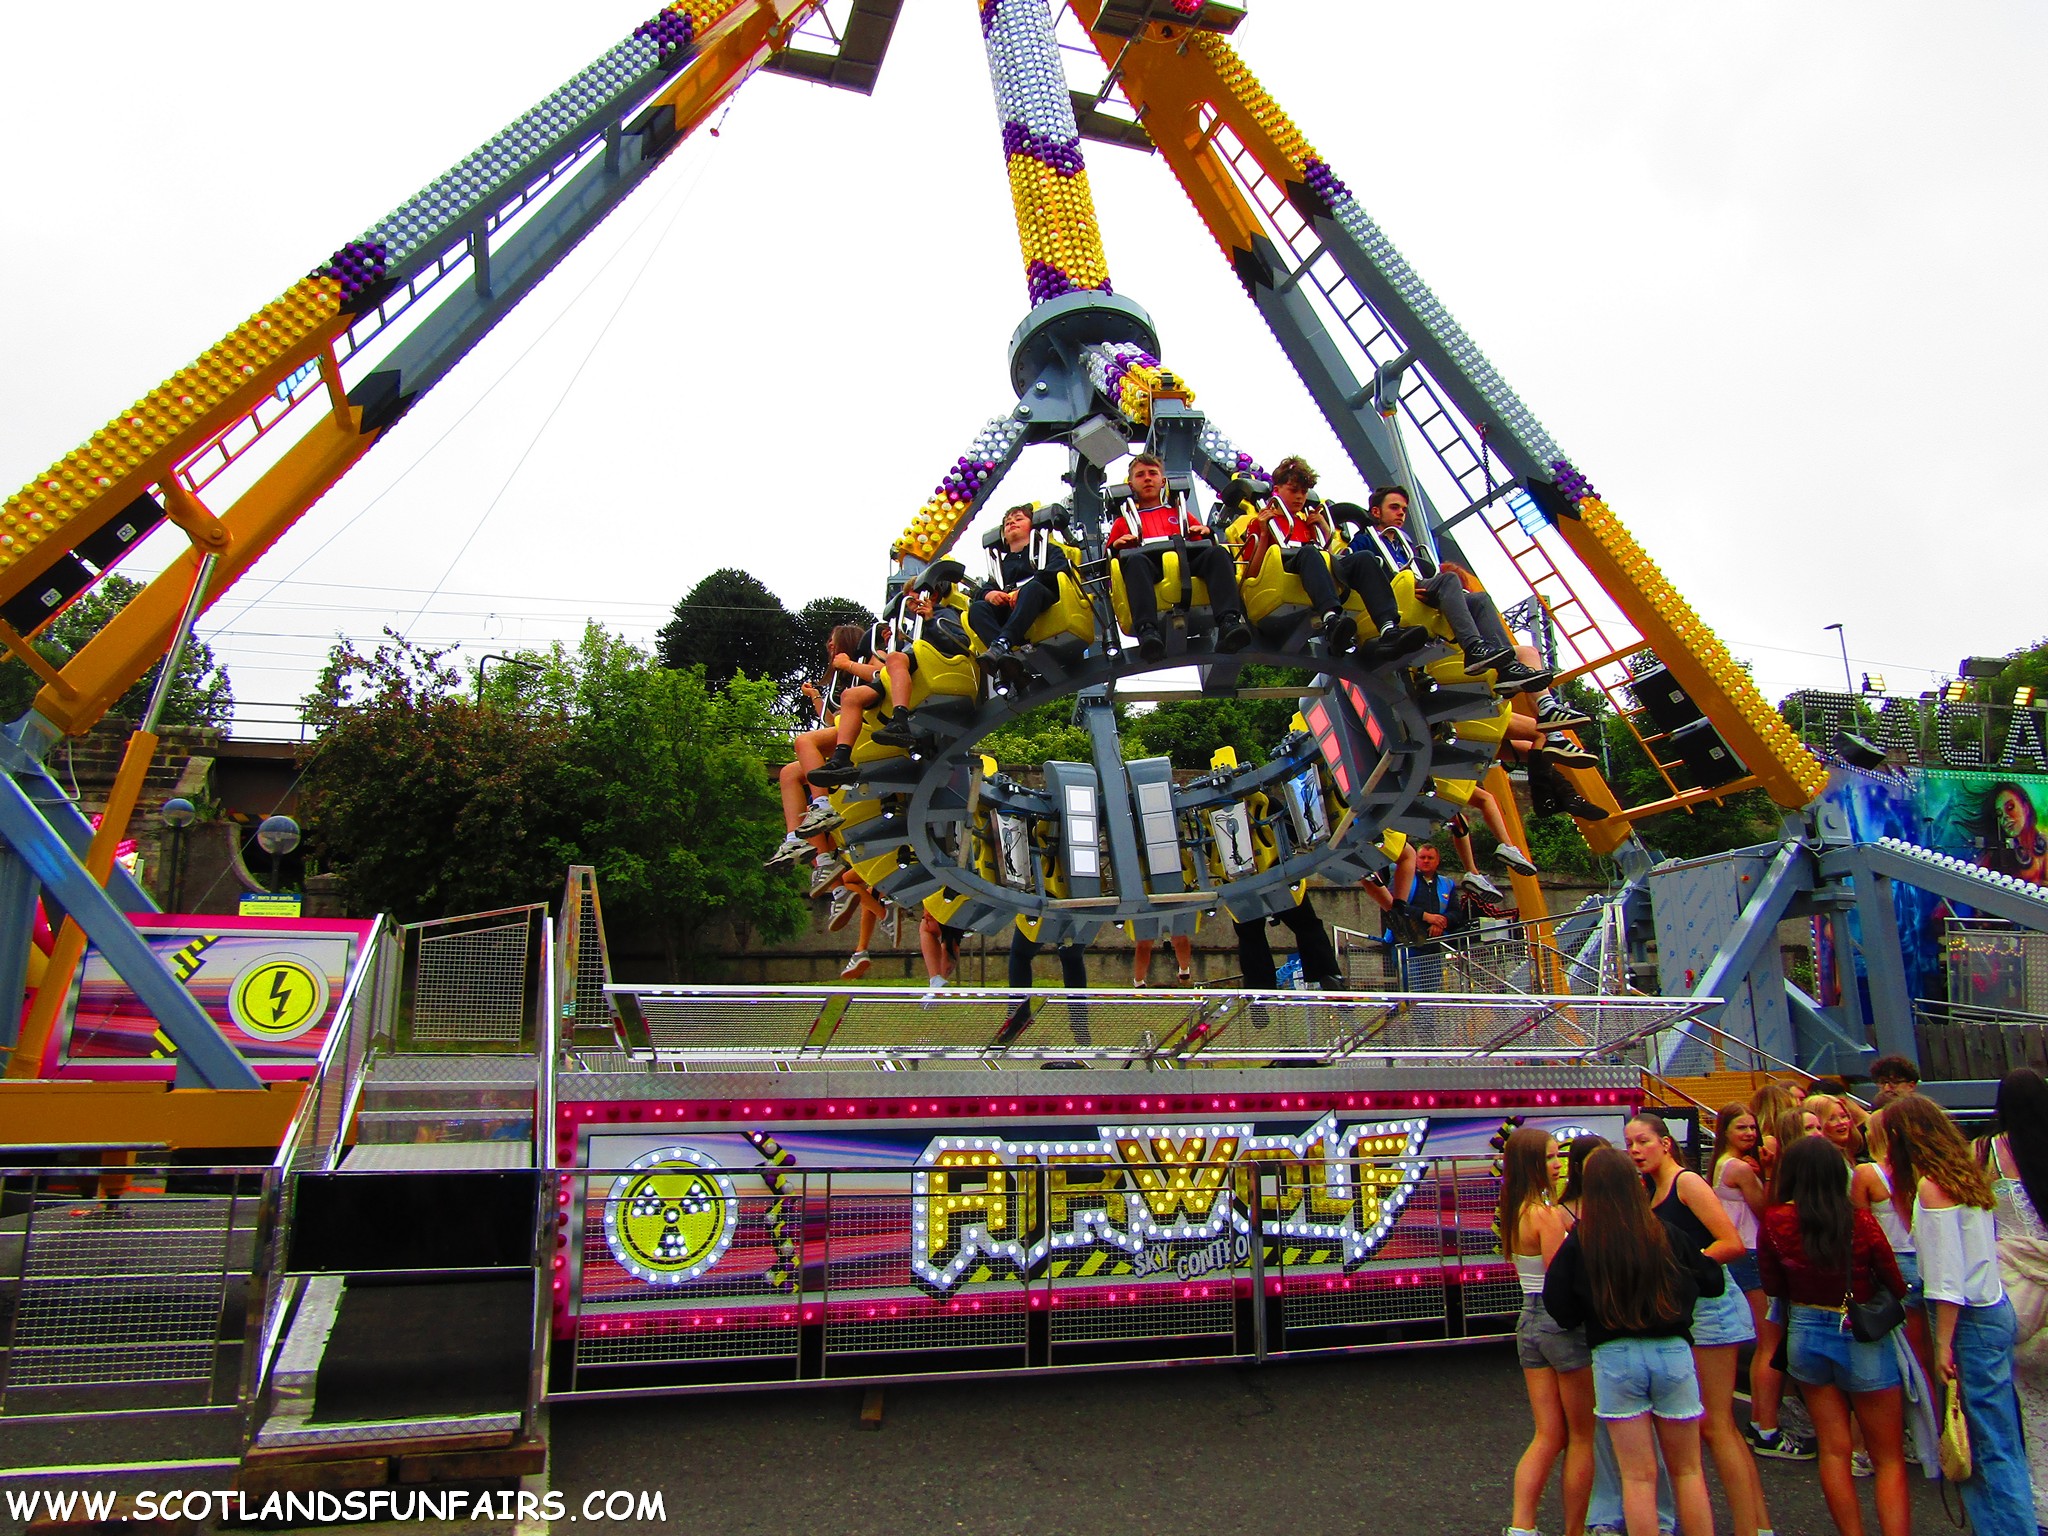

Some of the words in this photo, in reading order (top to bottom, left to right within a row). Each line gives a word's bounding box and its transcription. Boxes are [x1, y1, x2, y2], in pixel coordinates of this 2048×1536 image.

[920, 1122, 1421, 1276] AIRWOLF
[1133, 1242, 1171, 1278] SKY
[1177, 1233, 1251, 1281] CONTRO
